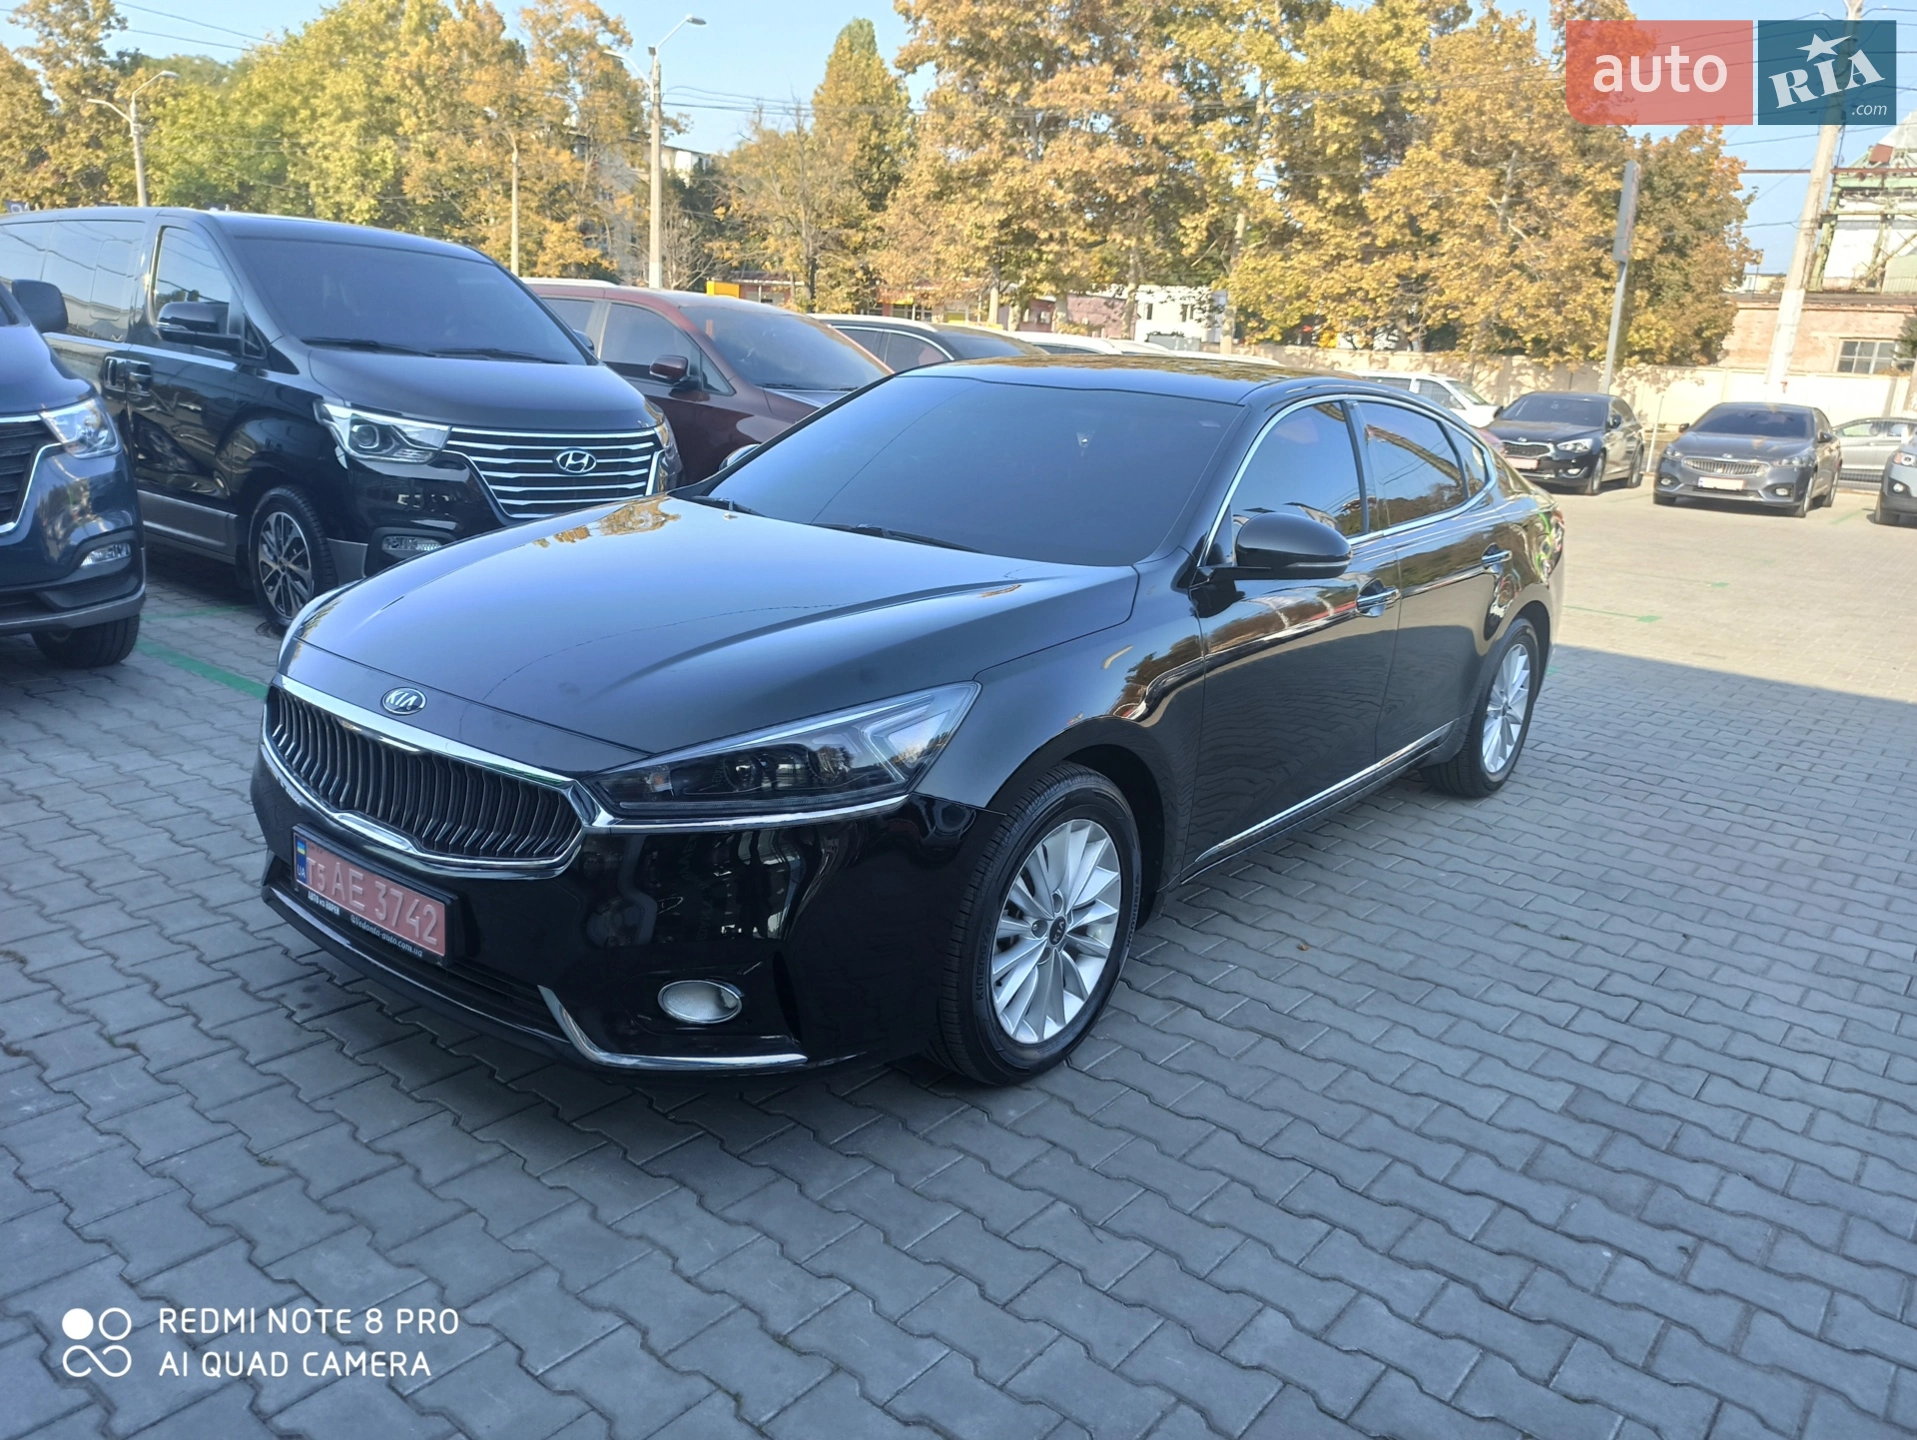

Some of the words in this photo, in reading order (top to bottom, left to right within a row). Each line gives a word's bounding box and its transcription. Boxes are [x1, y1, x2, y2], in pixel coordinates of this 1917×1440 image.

[385, 690, 418, 711] KIA
[374, 880, 438, 946] 3742
[1052, 921, 1065, 943] KIA
